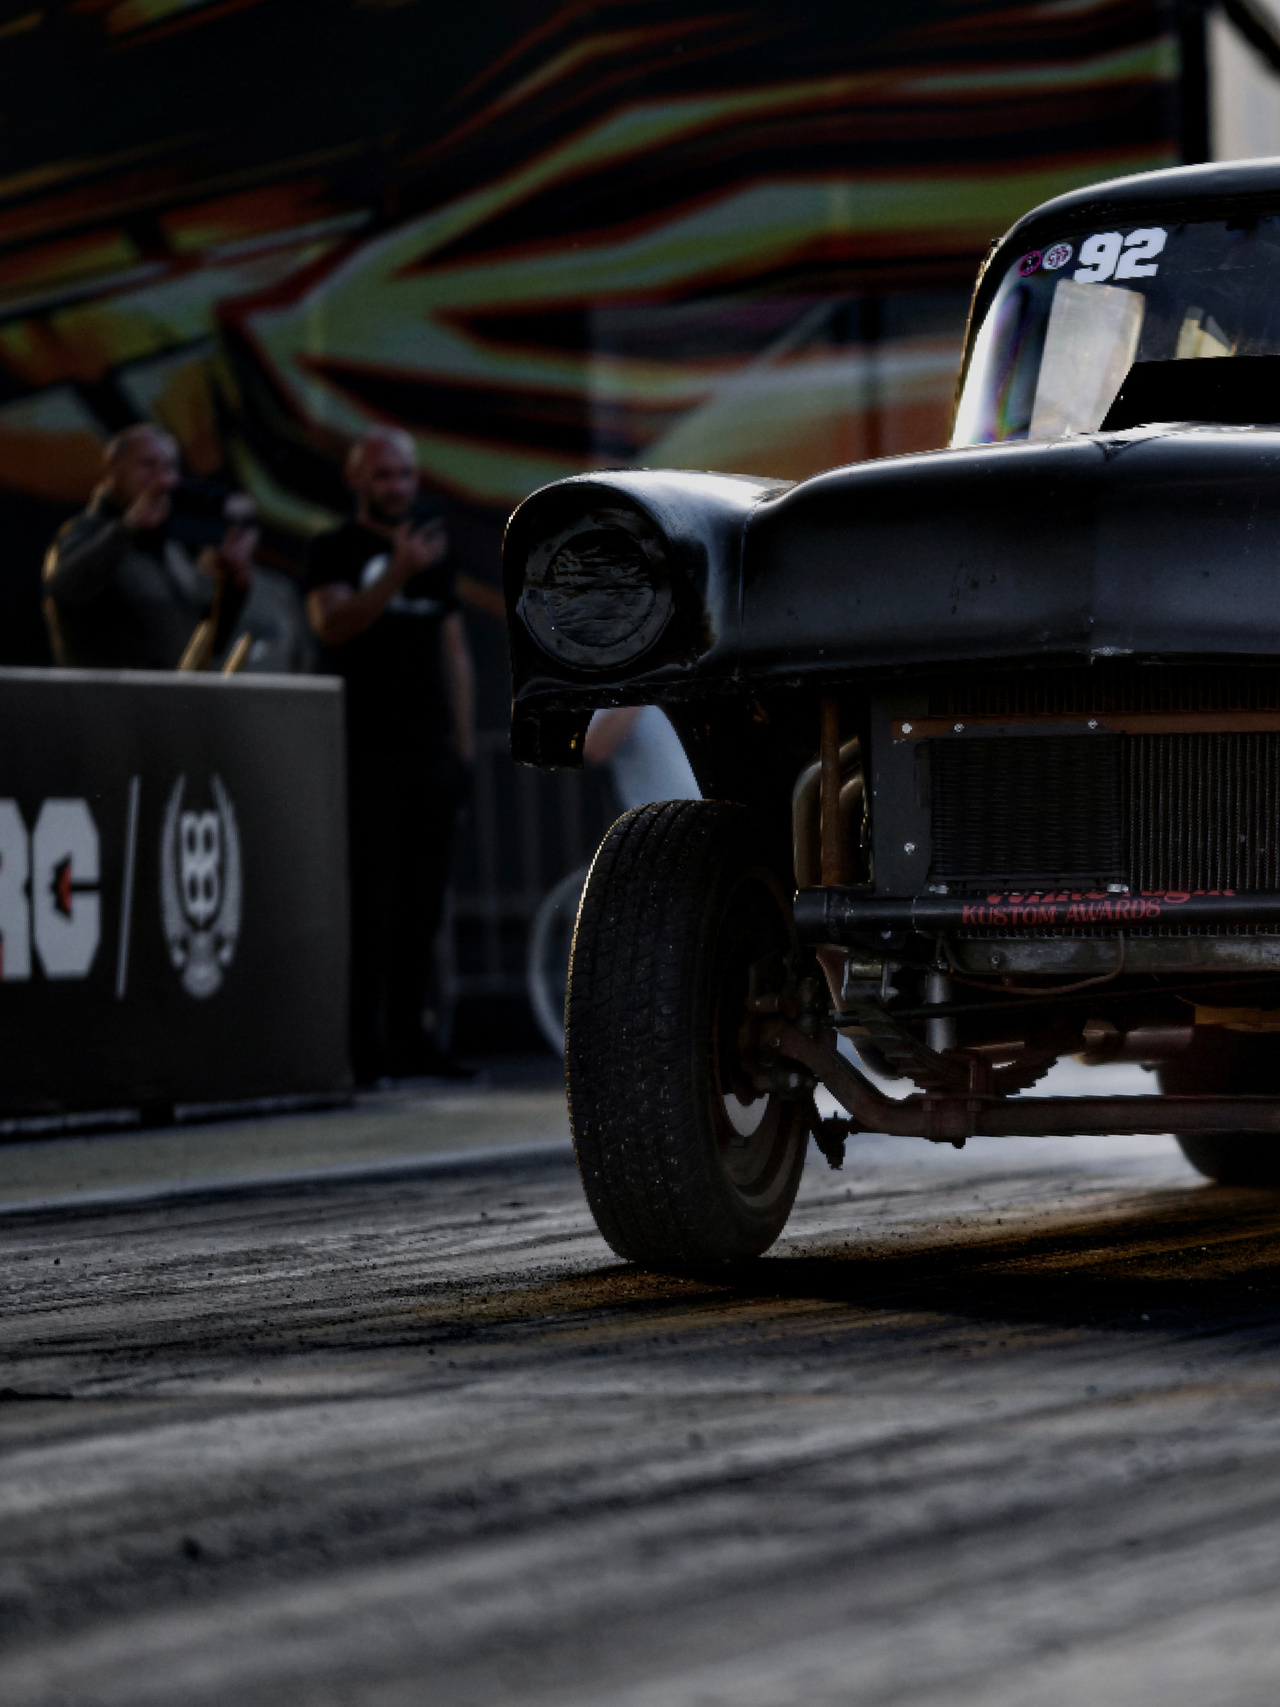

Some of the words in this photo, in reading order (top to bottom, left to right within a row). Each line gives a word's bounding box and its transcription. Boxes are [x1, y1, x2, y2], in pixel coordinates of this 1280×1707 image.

[1072, 228, 1169, 285] 92
[961, 904, 1058, 927] KUSTOM
[1064, 897, 1162, 923] AWARDS
